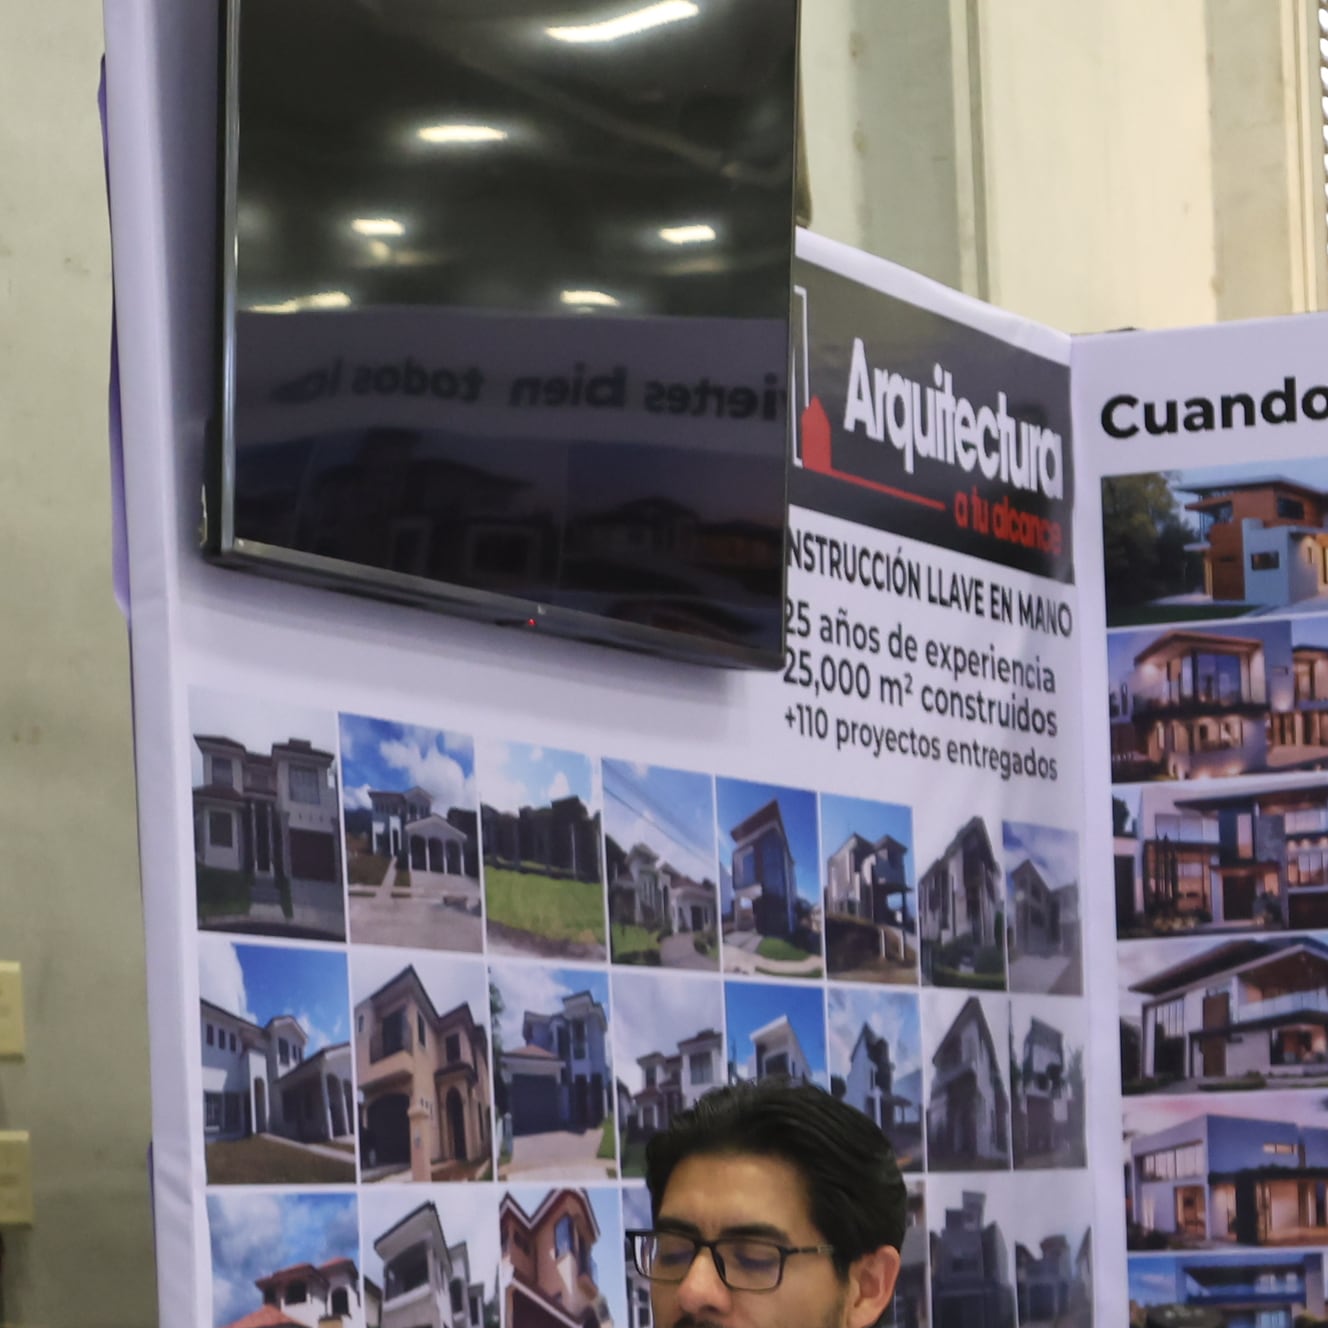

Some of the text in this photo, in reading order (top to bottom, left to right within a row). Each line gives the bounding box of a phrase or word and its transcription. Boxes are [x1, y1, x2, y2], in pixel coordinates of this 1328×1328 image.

[843, 337, 1063, 500] Arquitectura
[954, 485, 1063, 555] a tu alcance
[788, 527, 1073, 638] NSTRUCCIÓN LLAVE EN MANO
[786, 597, 1056, 694] 25 años de experiencia
[784, 648, 871, 698] 25,000
[921, 685, 1057, 737] construidos
[785, 703, 1058, 781] +110 proyectos entregados
